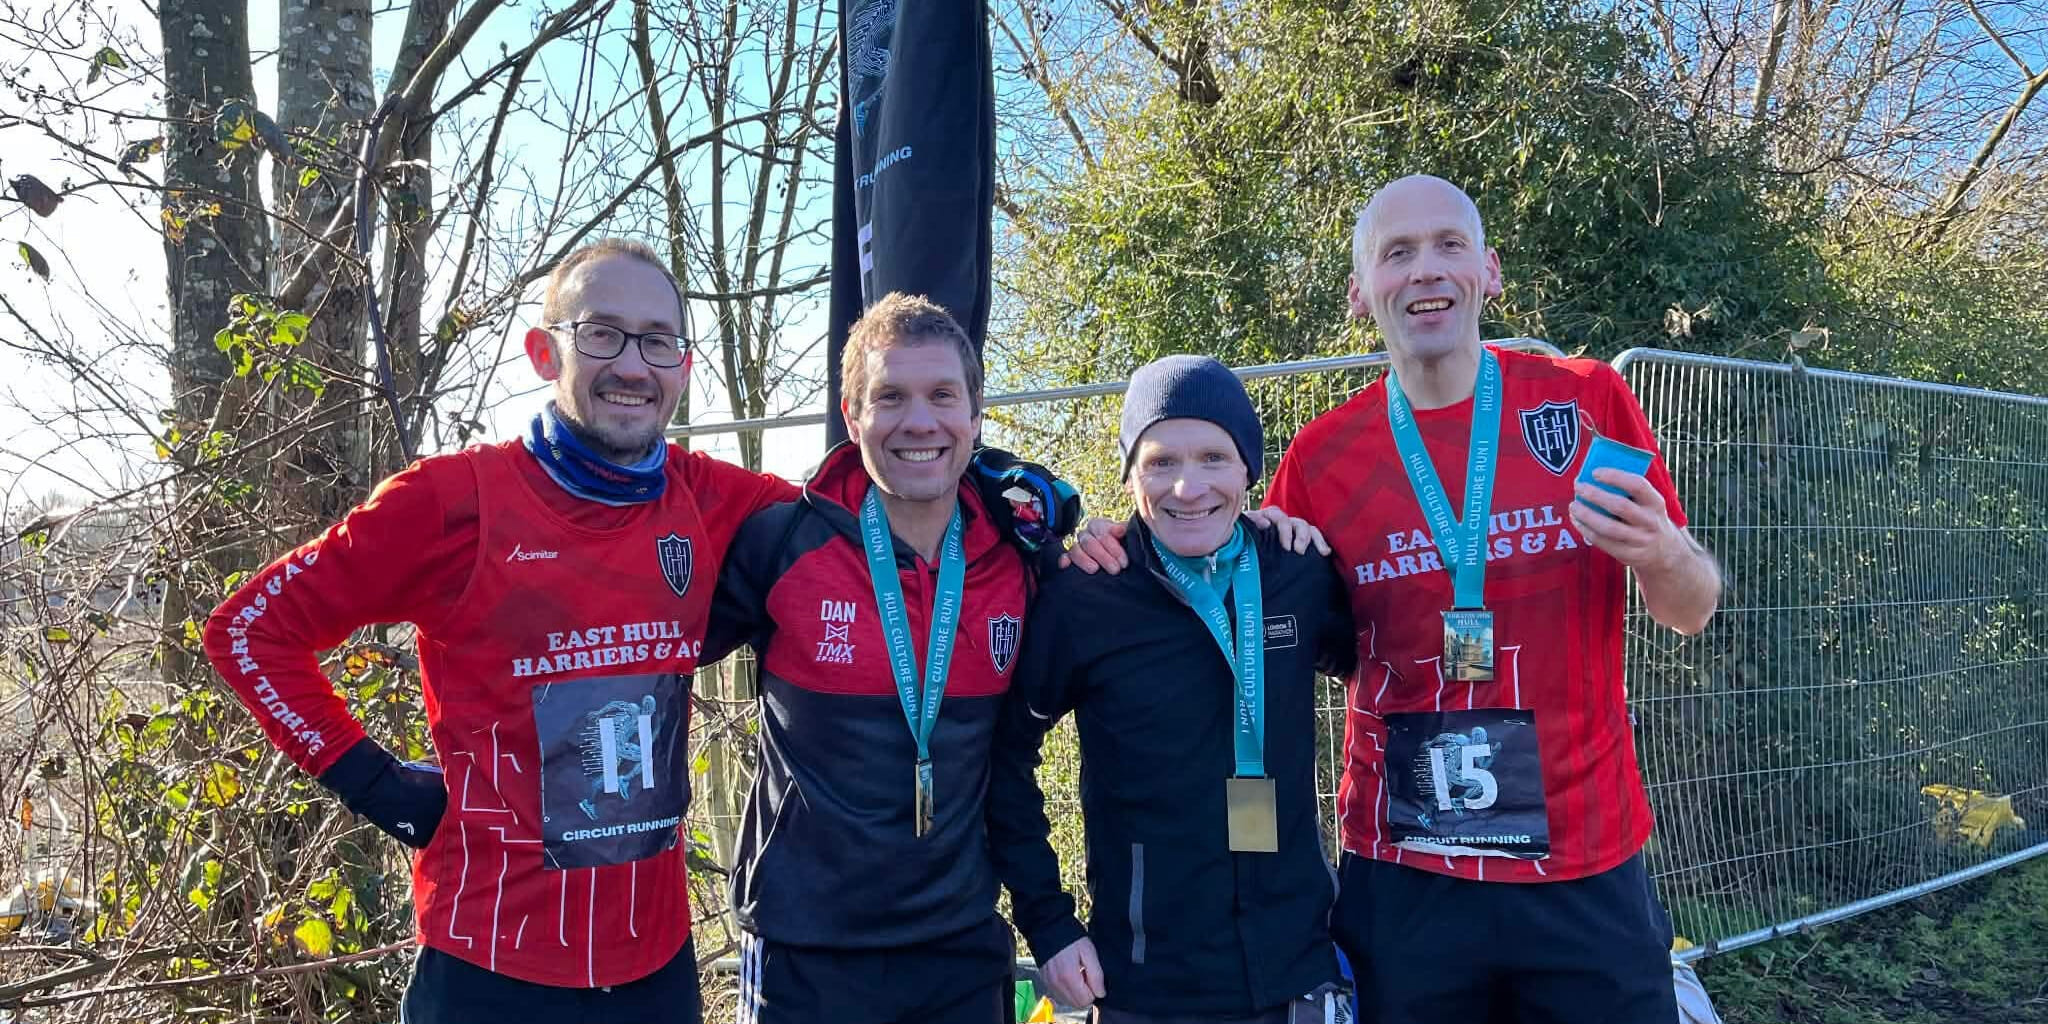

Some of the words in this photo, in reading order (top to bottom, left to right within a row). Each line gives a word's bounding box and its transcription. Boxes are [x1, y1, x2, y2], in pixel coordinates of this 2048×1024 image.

[1475, 447, 1488, 472] RUN
[1409, 453, 1429, 484] HULL
[1423, 484, 1452, 536] CULTURE
[1469, 475, 1485, 530] CULTURE
[871, 527, 886, 553] RUN
[1464, 533, 1478, 566] HULL
[1521, 532, 1546, 554] &
[518, 551, 558, 561] Scimitar
[1166, 562, 1189, 585] RUN
[821, 600, 856, 623] DAN
[941, 597, 953, 624] RUN
[1209, 607, 1230, 639] HULL
[1244, 611, 1255, 637] RUN
[547, 626, 617, 651] EAST
[622, 620, 684, 642] HULL
[816, 642, 856, 659] TMX
[512, 644, 649, 677] HARRIERS
[654, 641, 672, 660] &
[815, 656, 854, 664] SPORTS
[884, 592, 899, 625] HULL
[892, 627, 912, 684] CULTURE
[905, 686, 918, 712] RUN
[932, 627, 949, 683] CULTURE
[1245, 640, 1256, 698] CULTURE
[254, 676, 304, 731] HULL
[927, 685, 939, 719] HULL
[599, 714, 655, 794] 11
[1430, 743, 1498, 811] 15
[562, 825, 625, 842] CIRCUIT
[1460, 834, 1531, 844] RUNNING
